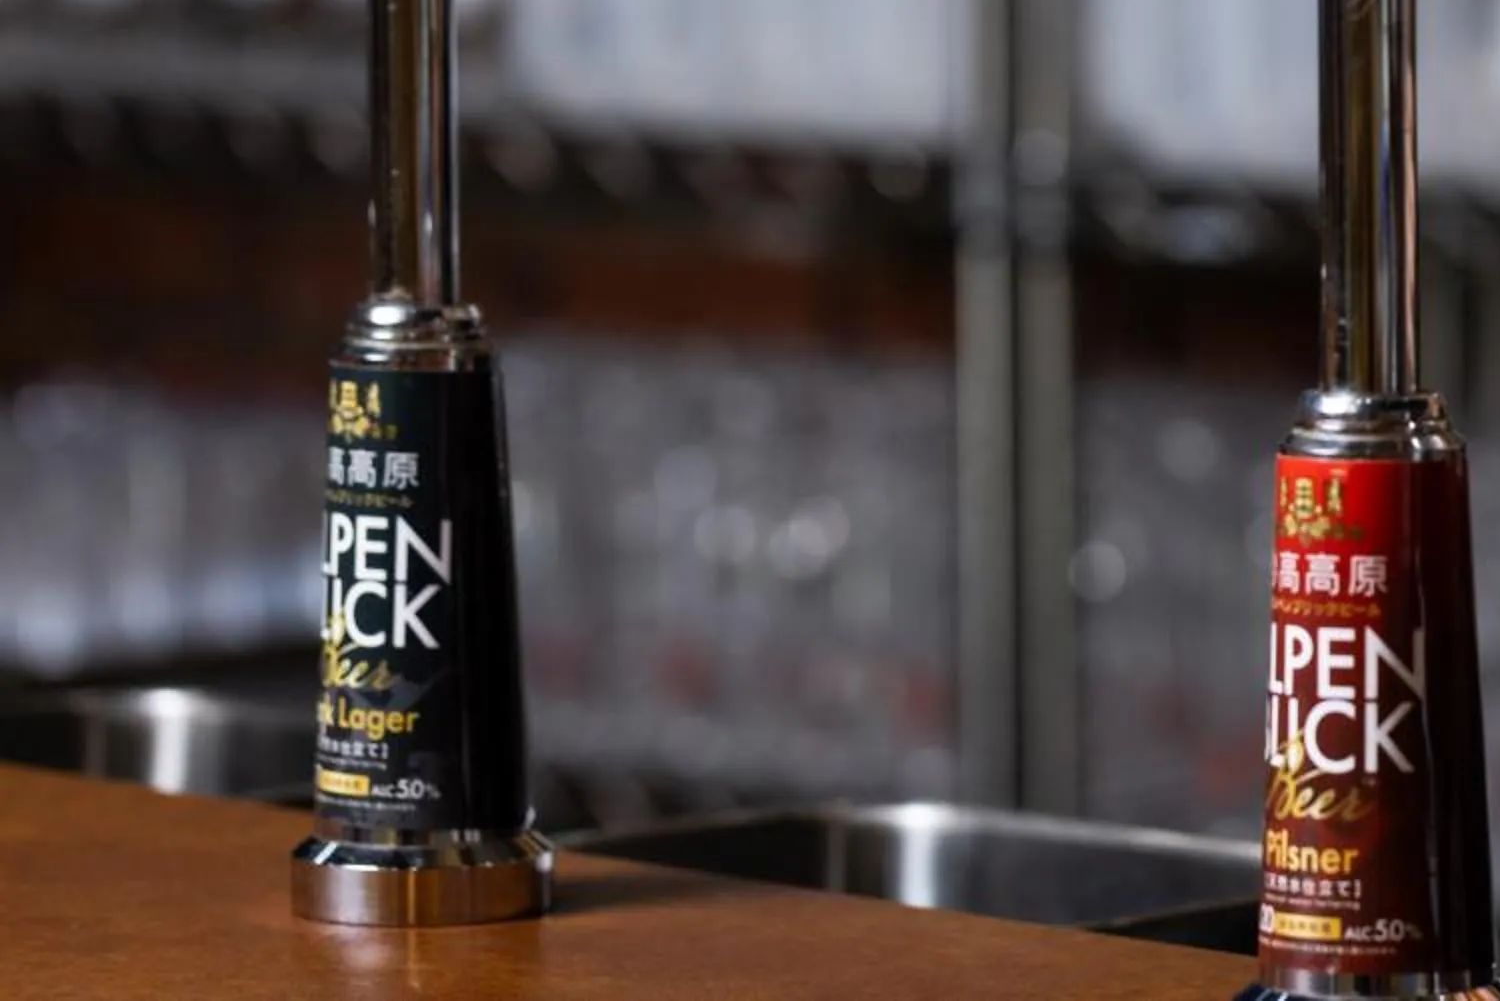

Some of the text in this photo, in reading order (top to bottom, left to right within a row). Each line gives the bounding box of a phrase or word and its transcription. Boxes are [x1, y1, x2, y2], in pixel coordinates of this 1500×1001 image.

[1271, 550, 1389, 597] 高高原
[337, 695, 420, 741] Lager
[1264, 694, 1416, 775] LICK
[1267, 731, 1374, 821] Beer
[1265, 828, 1360, 875] Pilsner
